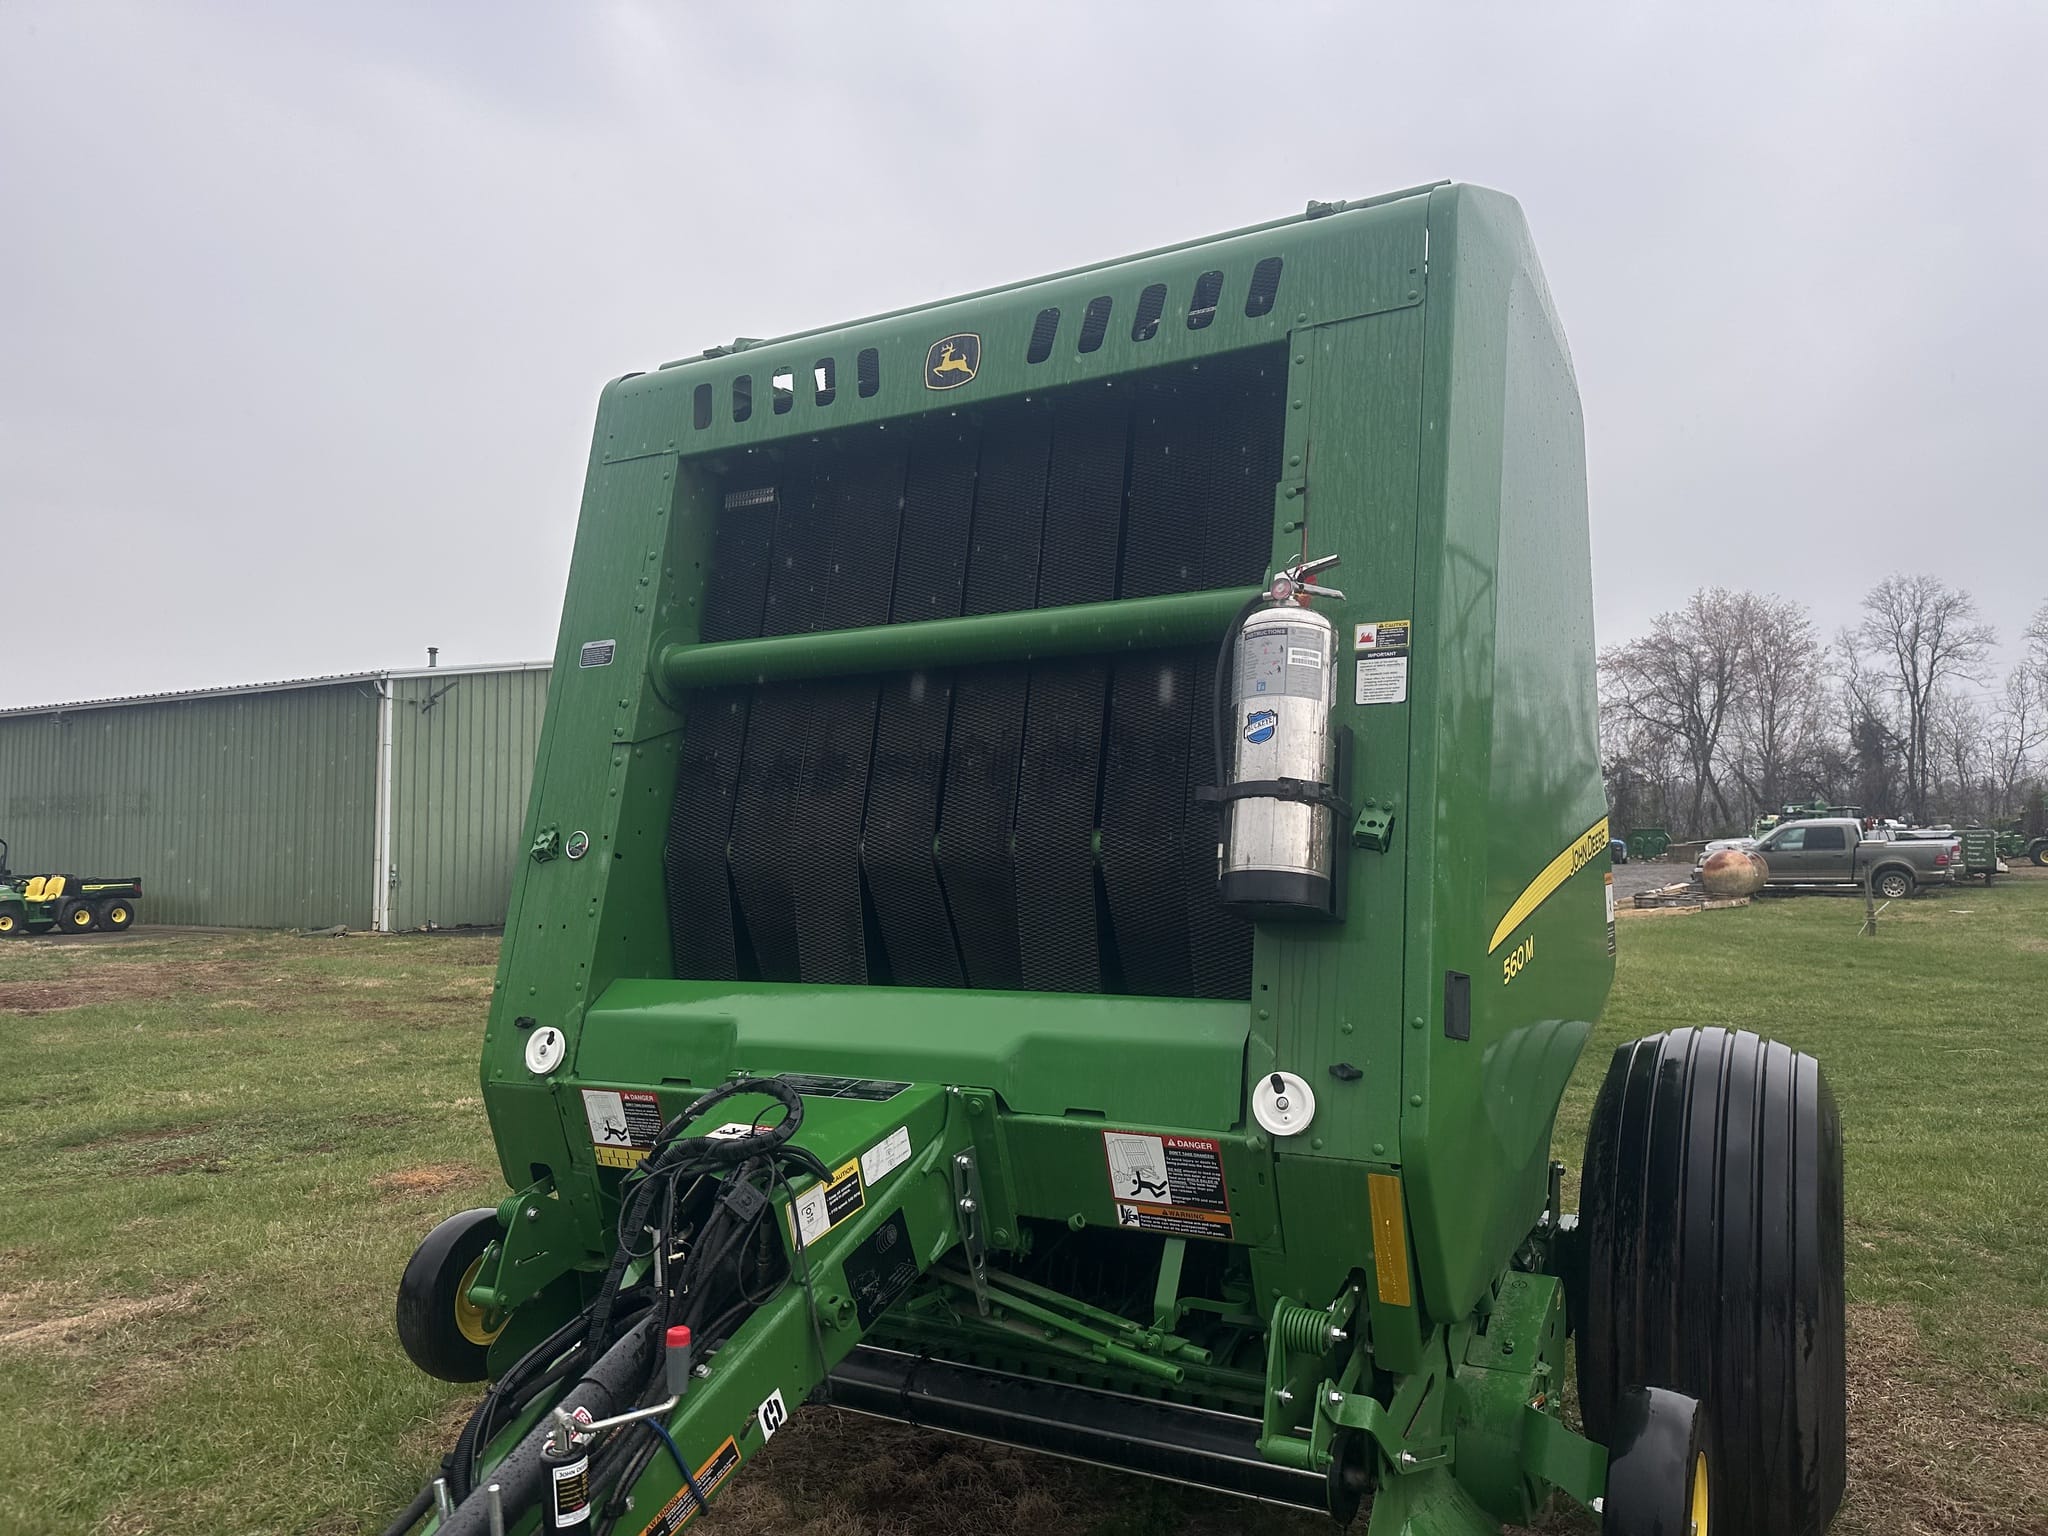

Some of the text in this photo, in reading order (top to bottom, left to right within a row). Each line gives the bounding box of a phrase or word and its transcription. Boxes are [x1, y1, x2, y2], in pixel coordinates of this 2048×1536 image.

[1246, 628, 1286, 639] INSTRUCTIONS
[1570, 828, 1605, 874] JOHN DEERE
[630, 1093, 654, 1102] DANGER
[1176, 1140, 1213, 1150] DANGER
[1168, 1209, 1204, 1219] WARNING
[559, 1468, 575, 1478] JOHN
[649, 1497, 676, 1527] WARNING
